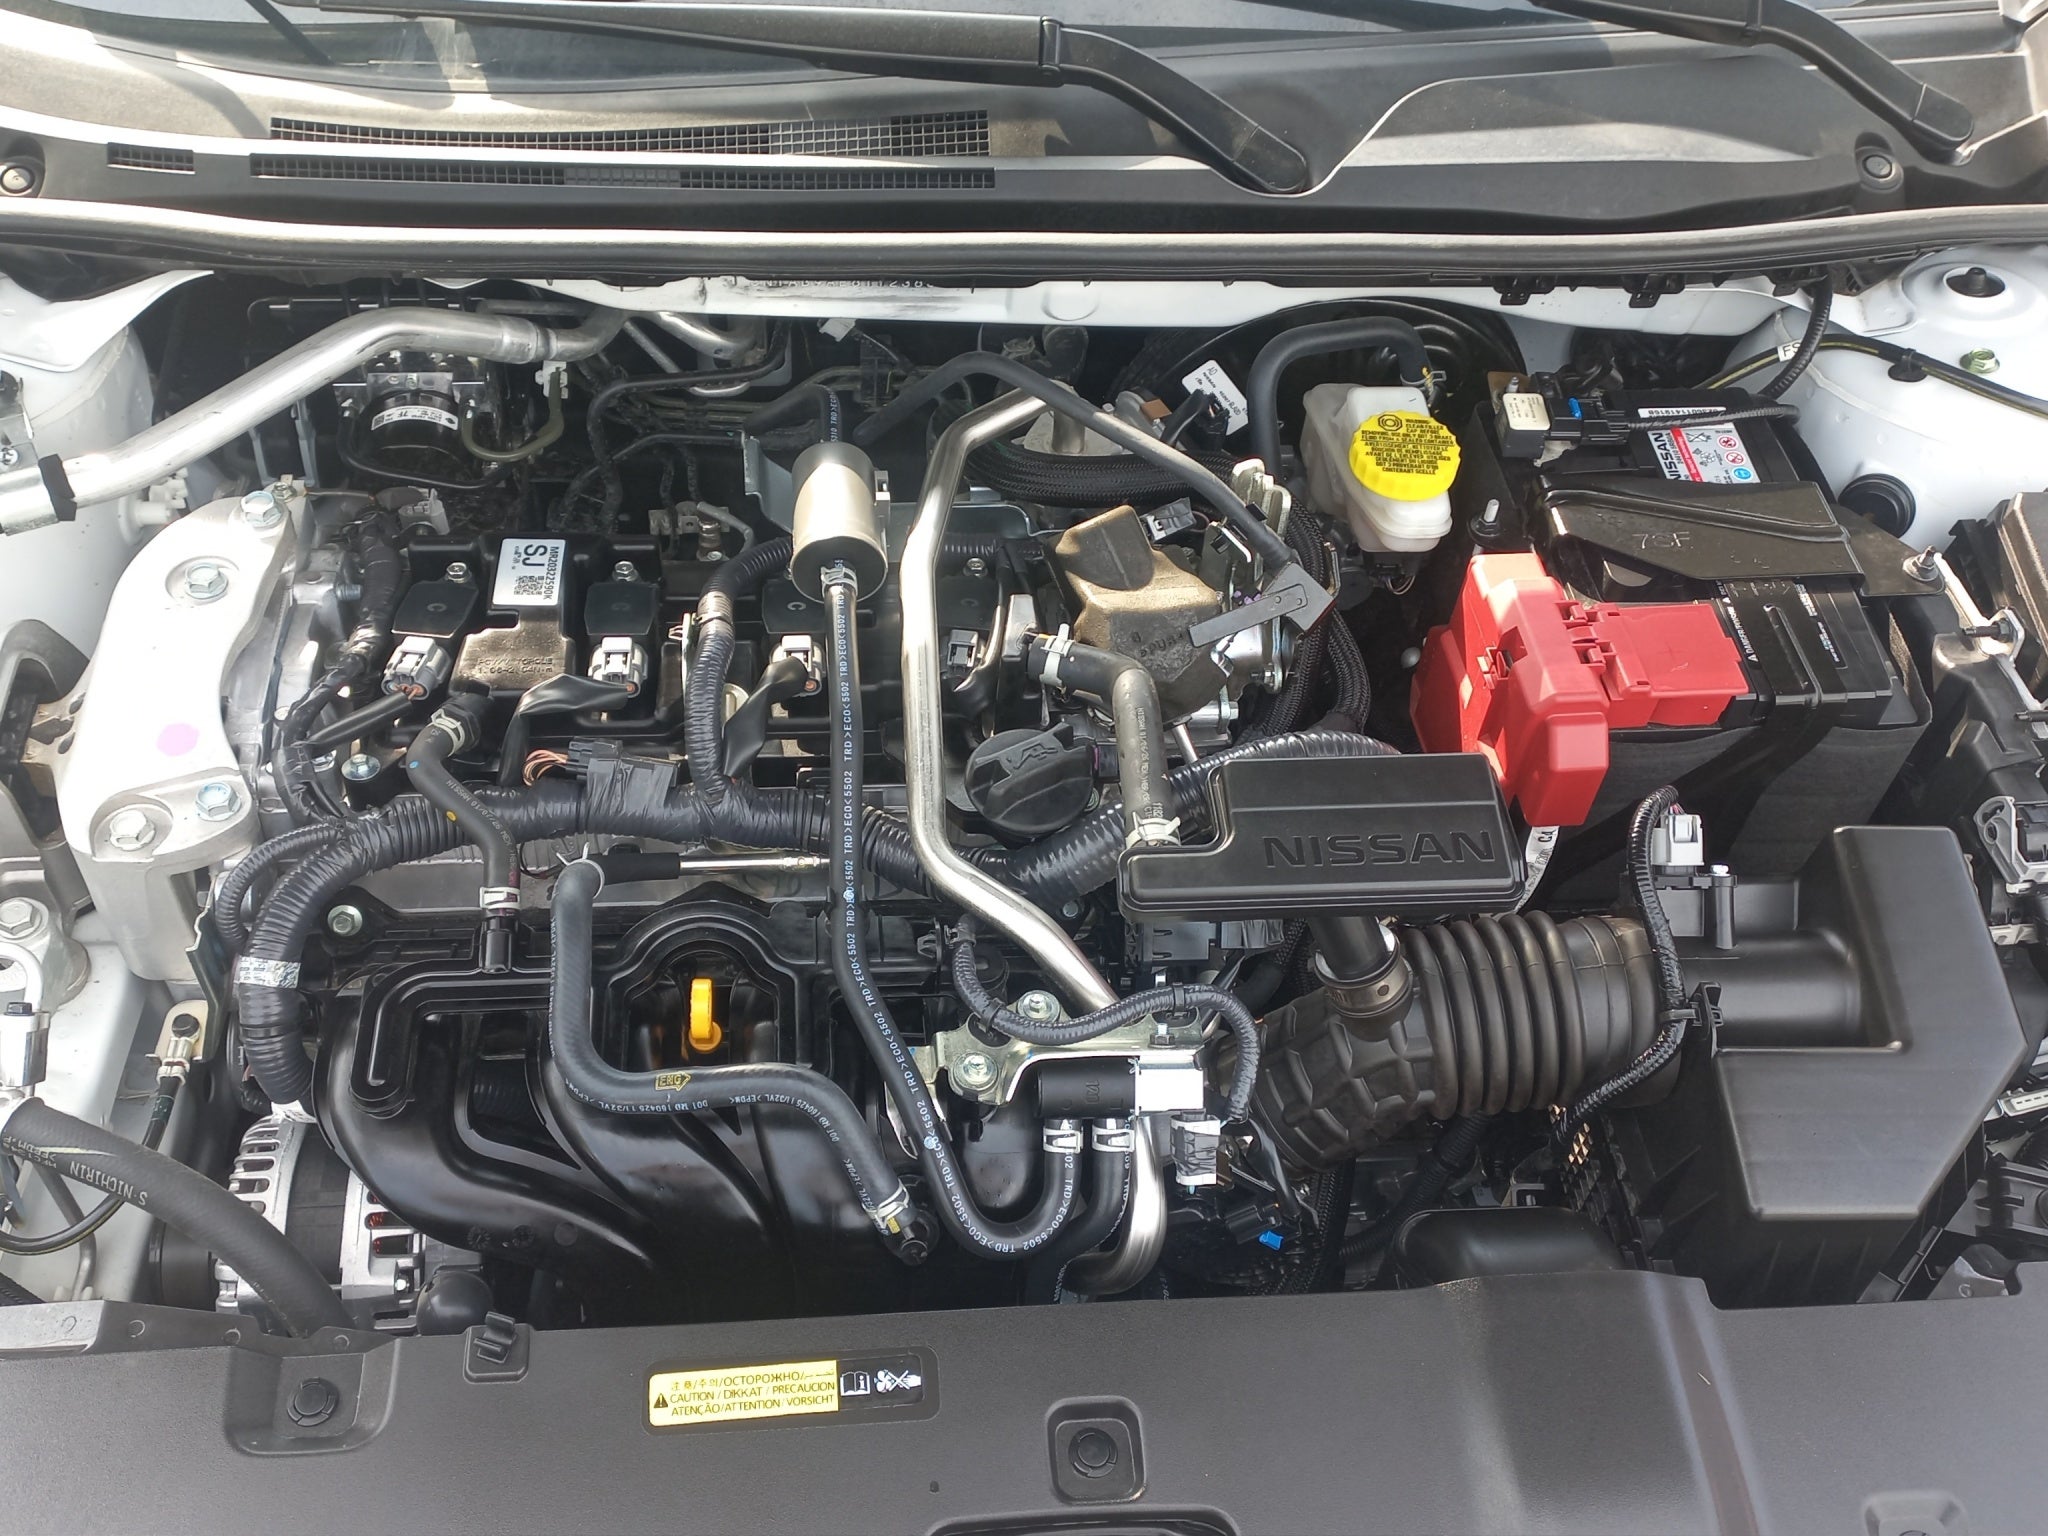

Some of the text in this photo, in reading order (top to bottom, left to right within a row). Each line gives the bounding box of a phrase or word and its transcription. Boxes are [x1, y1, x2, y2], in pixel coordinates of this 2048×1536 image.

[521, 544, 548, 567] SJ
[841, 682, 853, 762] TRD>ECO<5502
[843, 770, 853, 855] TRD>ECO<5502
[1262, 830, 1496, 869] NISSAN
[658, 1074, 683, 1087] ENG
[951, 1193, 1017, 1253] TRD>ECO<5502
[1022, 1178, 1074, 1250] TRD>ECO<5502
[669, 1391, 715, 1404] CAUTION
